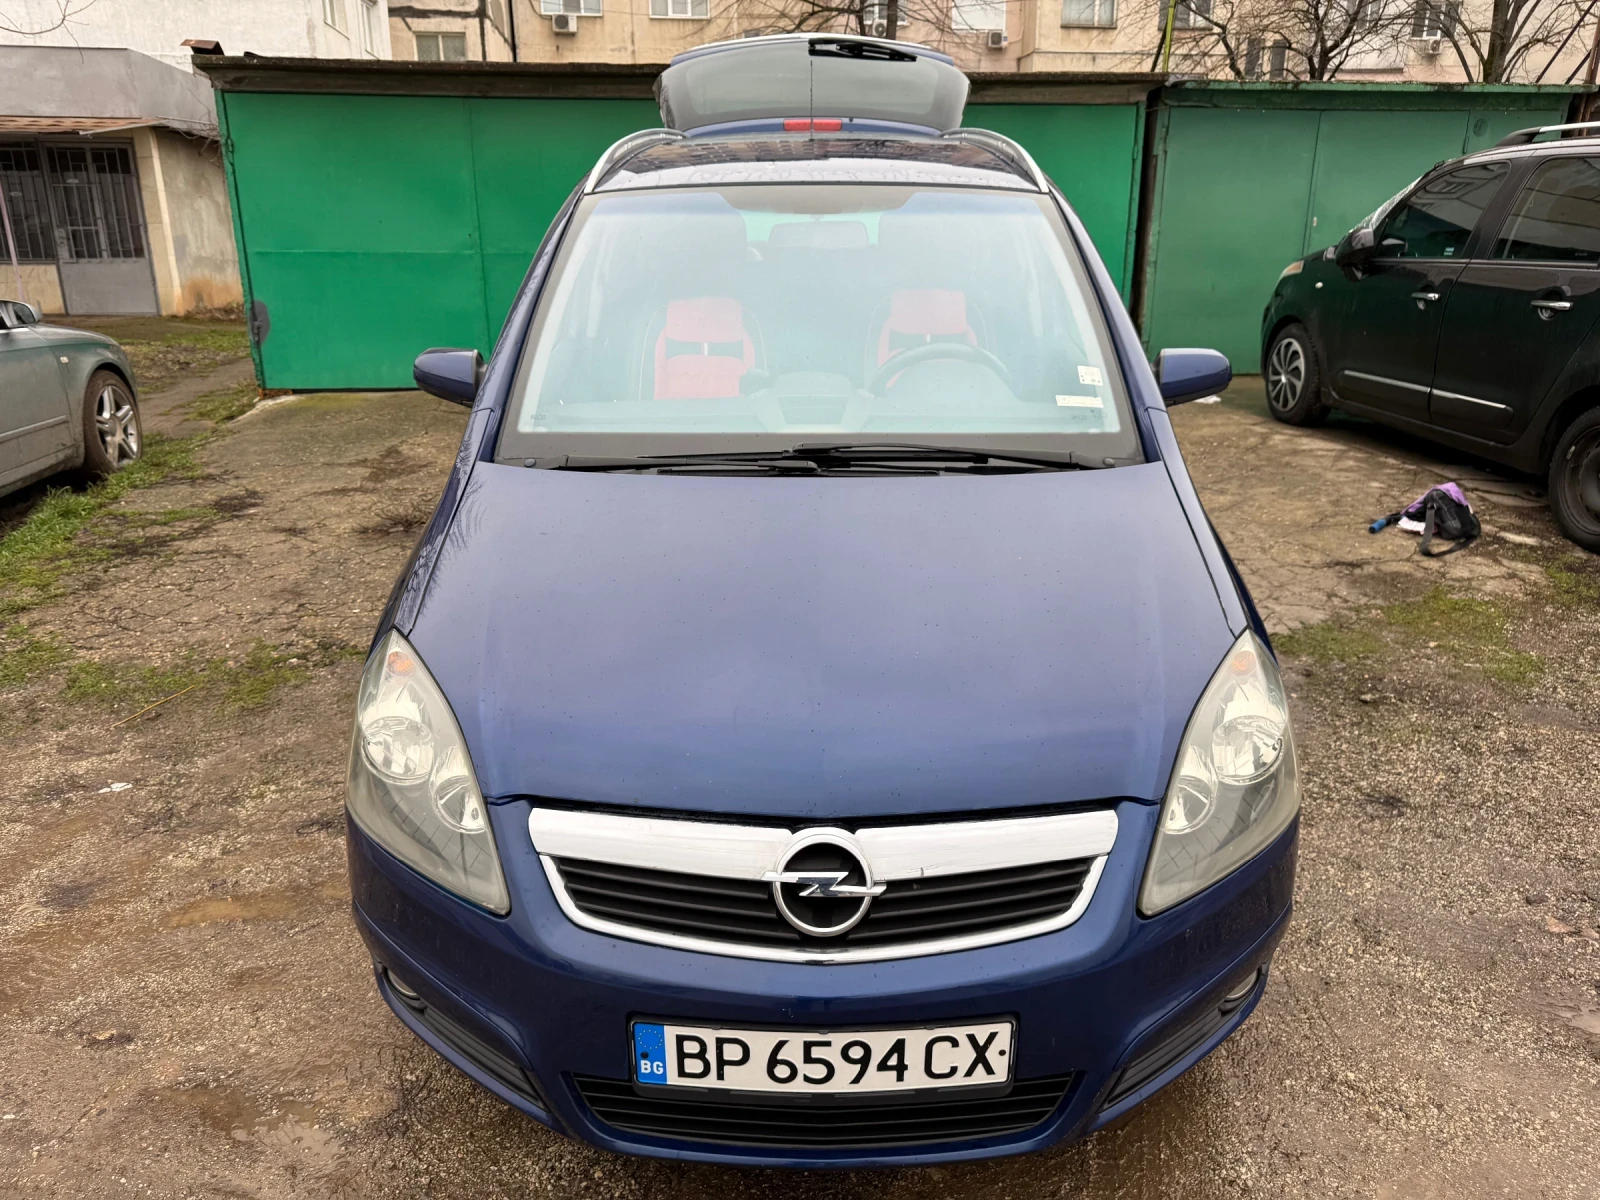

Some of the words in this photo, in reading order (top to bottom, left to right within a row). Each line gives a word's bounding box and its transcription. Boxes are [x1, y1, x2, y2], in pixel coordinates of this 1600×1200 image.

[640, 1060, 664, 1075] BG
[675, 1033, 751, 1081] BP
[766, 1038, 909, 1085] 6594
[924, 1031, 999, 1080] CX
